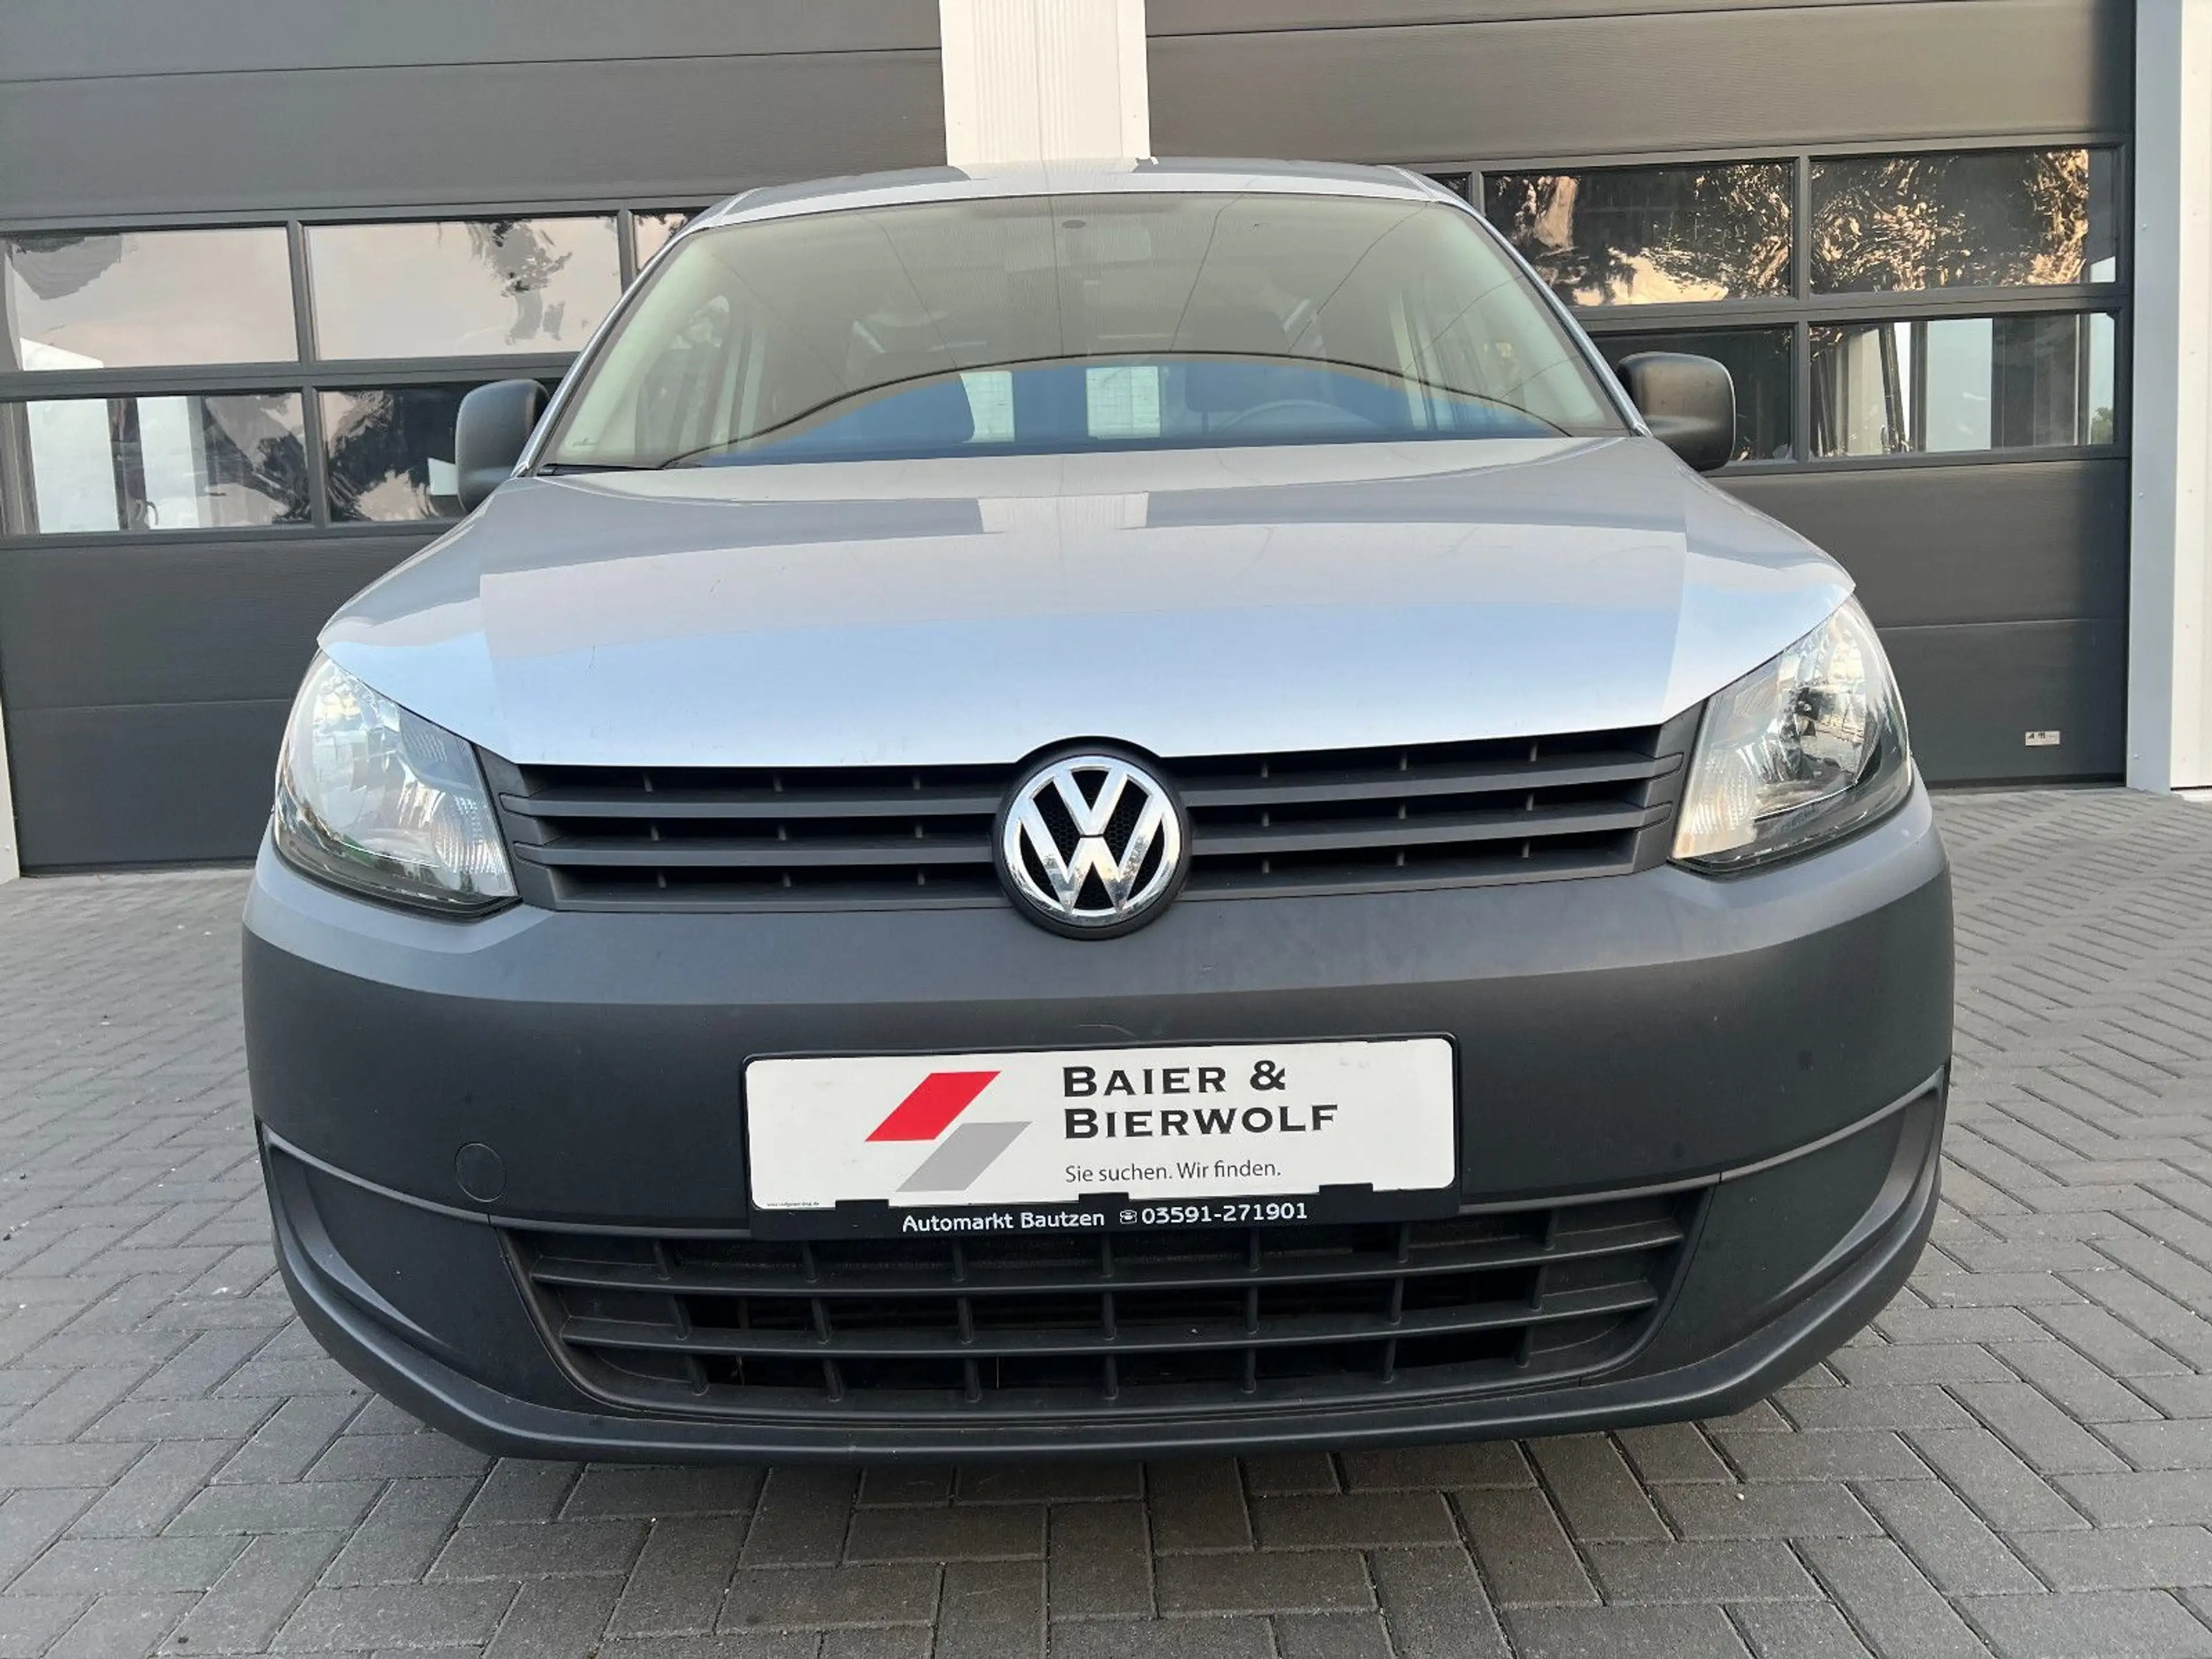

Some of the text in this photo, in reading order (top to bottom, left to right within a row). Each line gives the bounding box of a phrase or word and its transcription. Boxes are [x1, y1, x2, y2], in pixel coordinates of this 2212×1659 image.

[1003, 755, 1180, 926] VW
[1063, 1060, 1286, 1097] BAIER &
[1064, 1104, 1338, 1139] BIERWOLF
[1066, 1160, 1282, 1183] Sie suchen. Wir finden.
[903, 1202, 1308, 1232] Automarkt Bautzen 03591-271901
